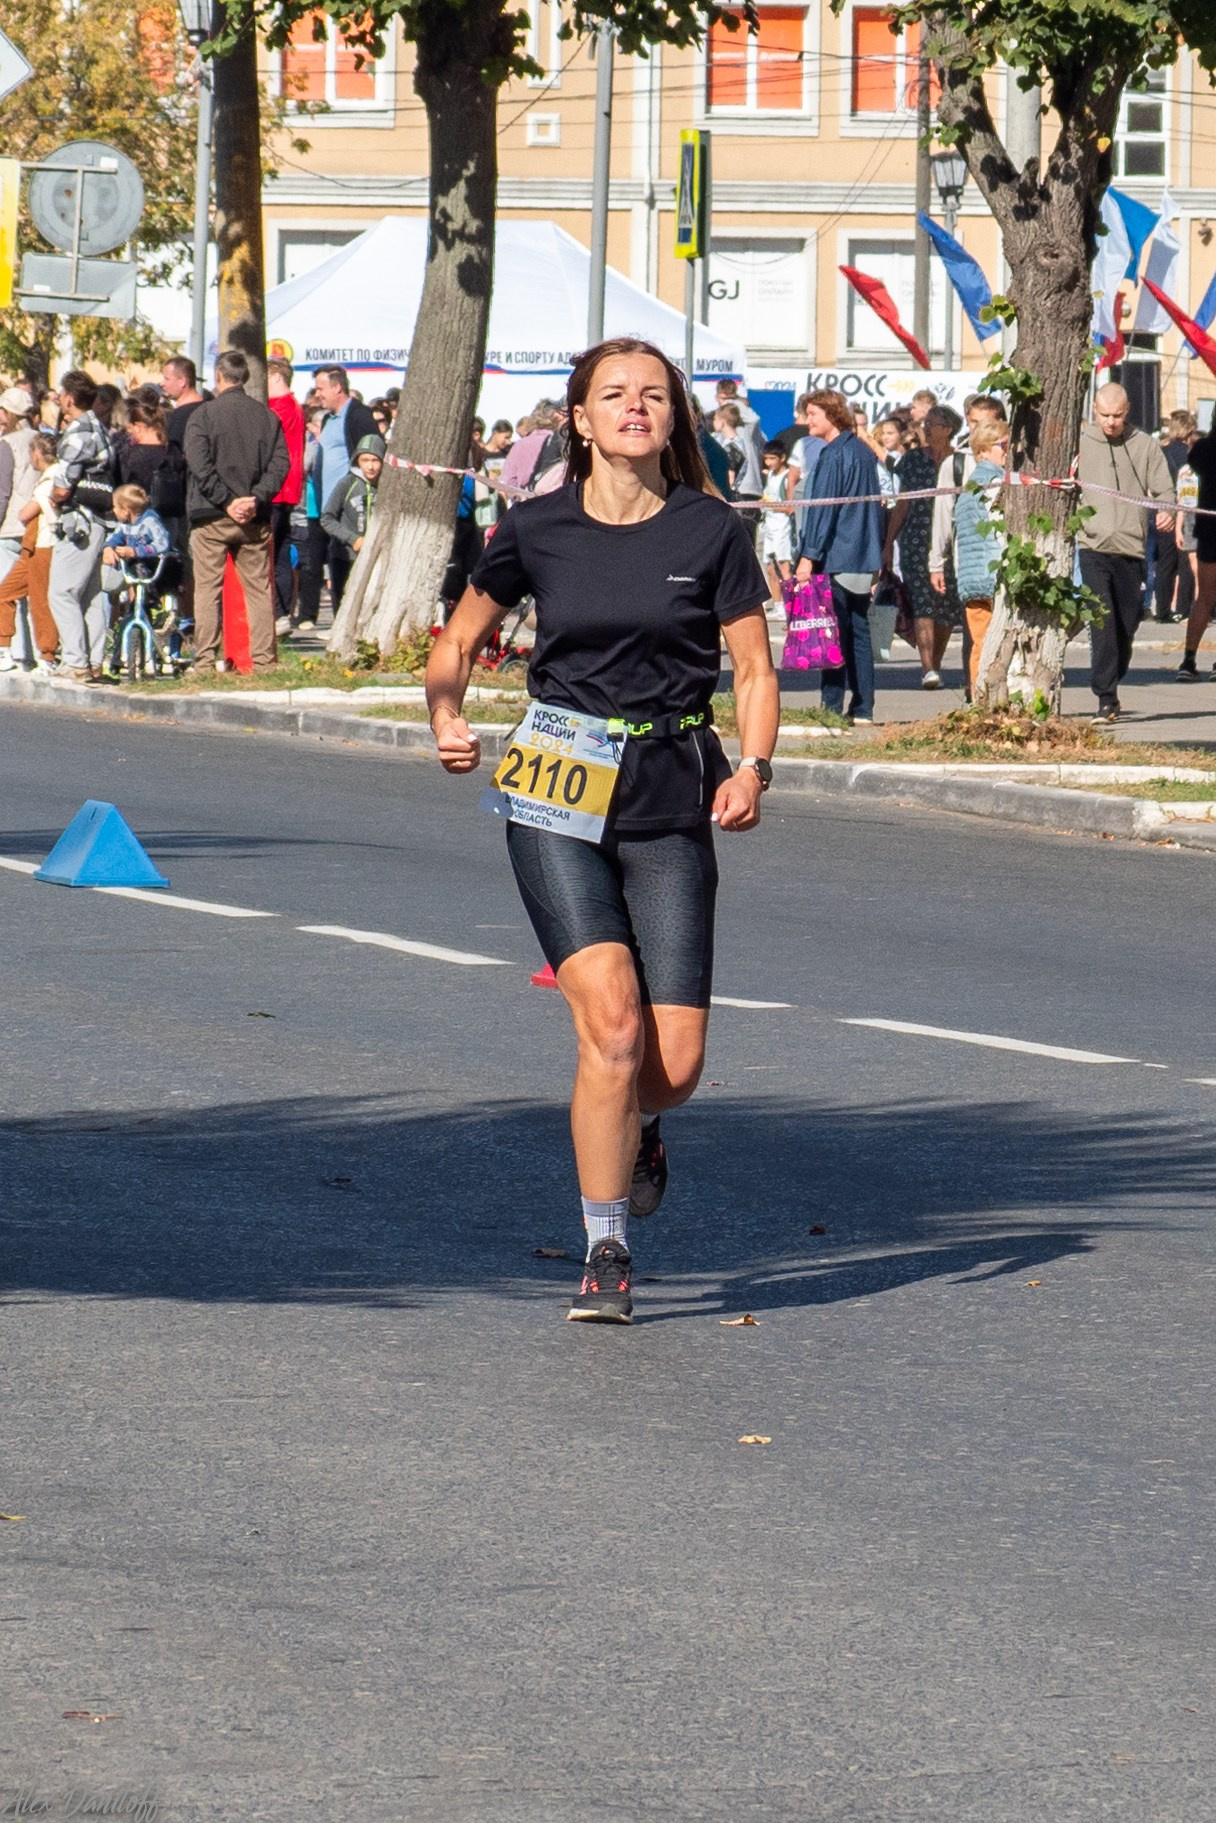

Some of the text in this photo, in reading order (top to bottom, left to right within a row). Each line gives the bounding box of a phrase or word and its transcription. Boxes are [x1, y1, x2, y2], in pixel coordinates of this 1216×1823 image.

[708, 279, 740, 300] GJ
[305, 347, 354, 361] КОМИТЕТ
[357, 348, 370, 362] ПО
[514, 351, 555, 364] СПОРТУ
[695, 358, 733, 371] МУРОМ
[806, 372, 887, 398] КРОСС
[533, 709, 570, 727] КРОСС
[531, 721, 576, 741] НАЦИИ
[529, 732, 574, 756] 2024
[500, 747, 588, 805] 2110
